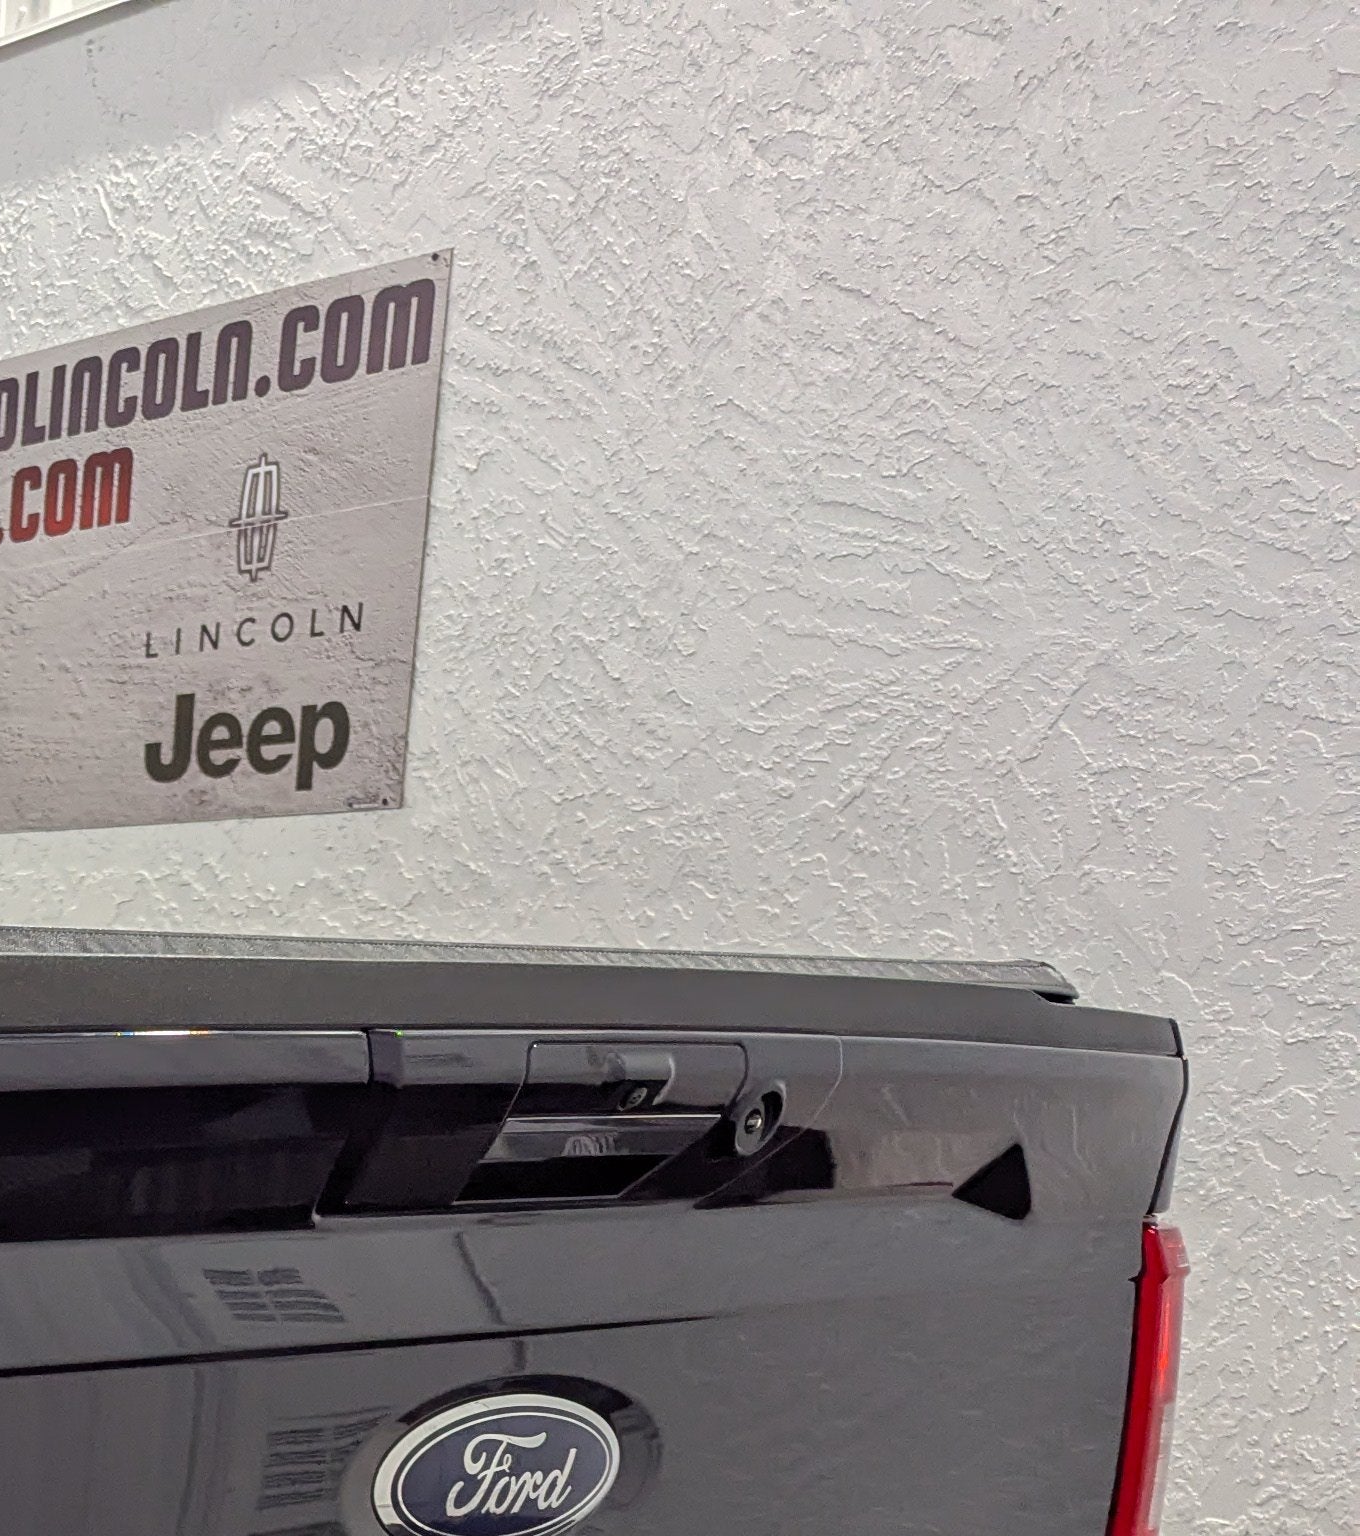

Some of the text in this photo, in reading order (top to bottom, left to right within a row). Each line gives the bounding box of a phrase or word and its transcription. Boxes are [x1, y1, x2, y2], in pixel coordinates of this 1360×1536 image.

[144, 601, 364, 659] LINCOLN
[144, 692, 350, 792] Jeep
[445, 1431, 578, 1518] Ford
